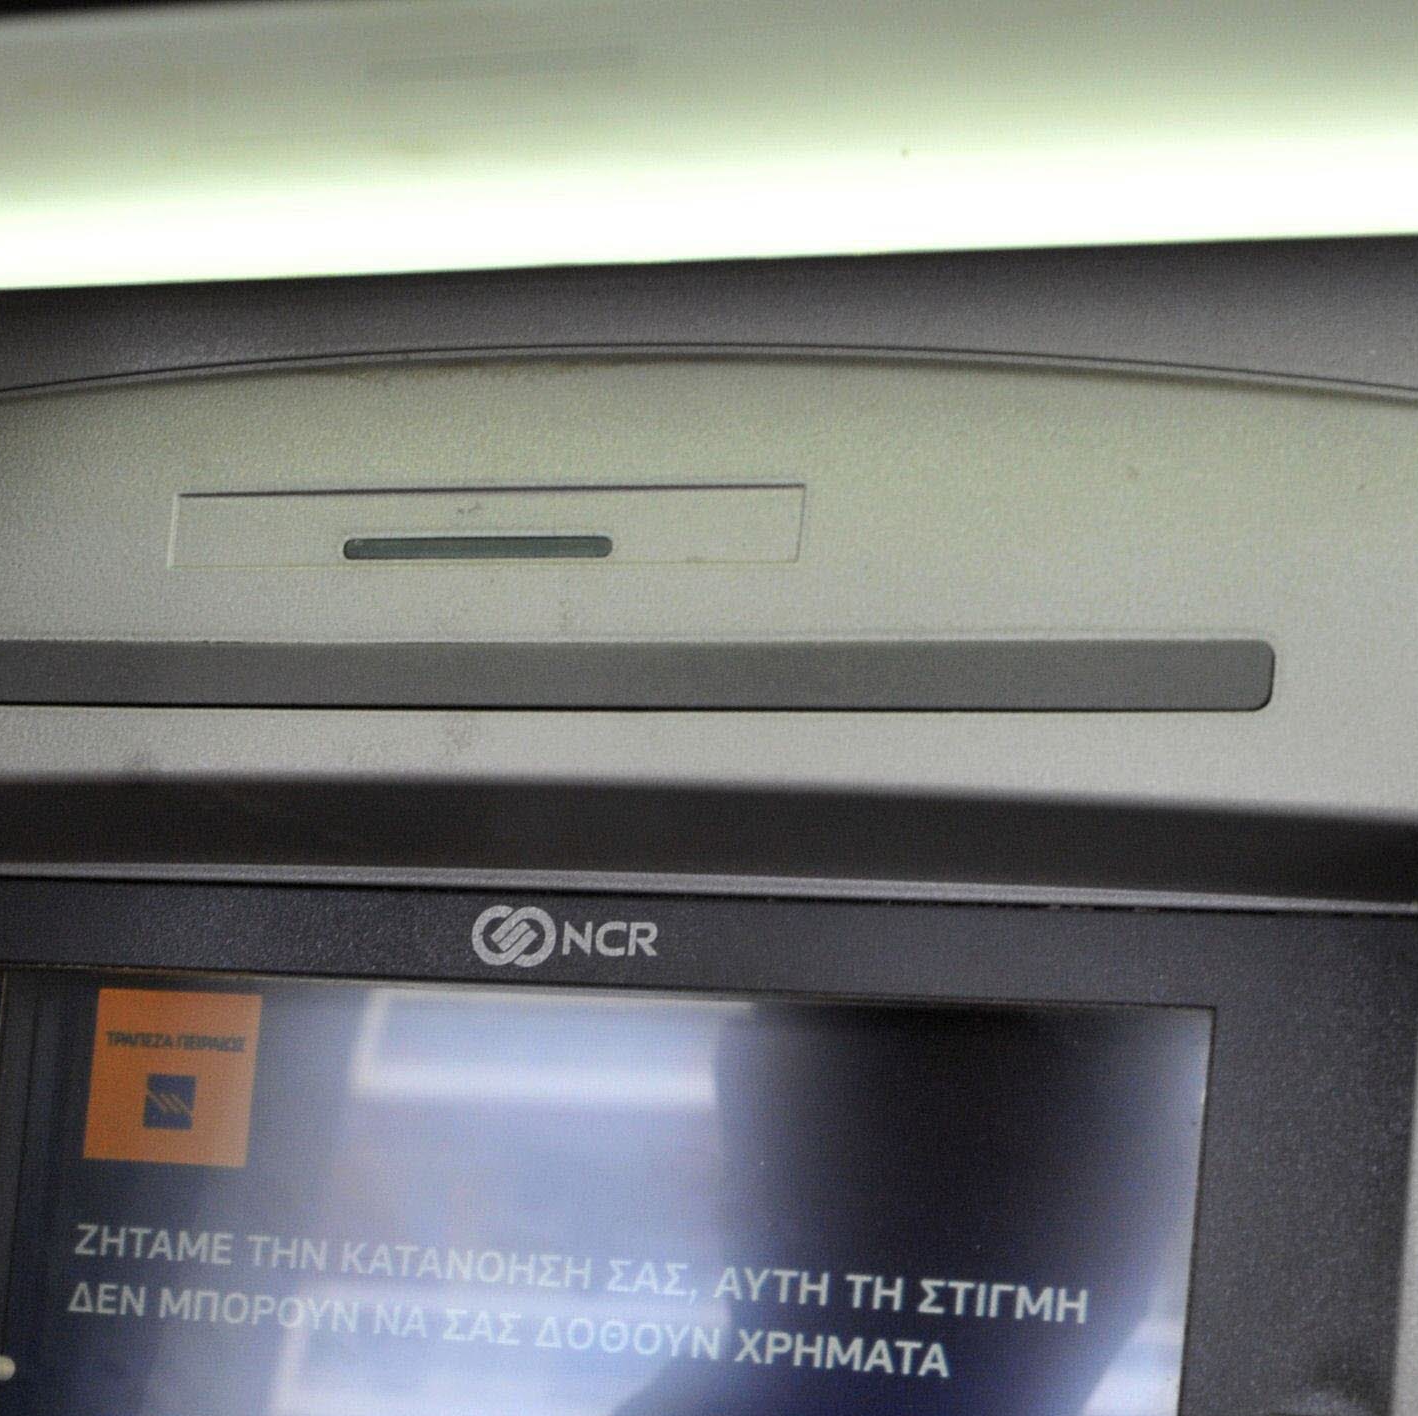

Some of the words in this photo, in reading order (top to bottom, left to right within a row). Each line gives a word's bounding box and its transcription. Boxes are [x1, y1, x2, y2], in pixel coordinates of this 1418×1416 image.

[562, 920, 658, 957] NCR
[107, 1031, 172, 1048] ΤΡΑΠΕΖΑ
[74, 1224, 233, 1266] ΖΗΤΑΜΕ
[248, 1235, 328, 1272] ΤΗΝ
[340, 1241, 592, 1289] ΚΑΤΑΝΟΗΣΗ
[607, 1259, 698, 1303] ΣΑΣ,
[713, 1266, 829, 1306] ΑΥΤΗ
[846, 1274, 903, 1311] ΤΗ
[918, 1278, 1088, 1324] ΣΤΙΓΜΗ
[68, 1282, 146, 1318] ΔΕΝ
[158, 1288, 357, 1335] ΜΠΟΡΟΥΝ
[374, 1304, 428, 1338] ΝΑ
[442, 1308, 522, 1346] ΣΑΣ
[535, 1315, 720, 1360] ΔΟΘΟΥΝ
[734, 1328, 950, 1378] ΧΡΗΜΑΤΑ
